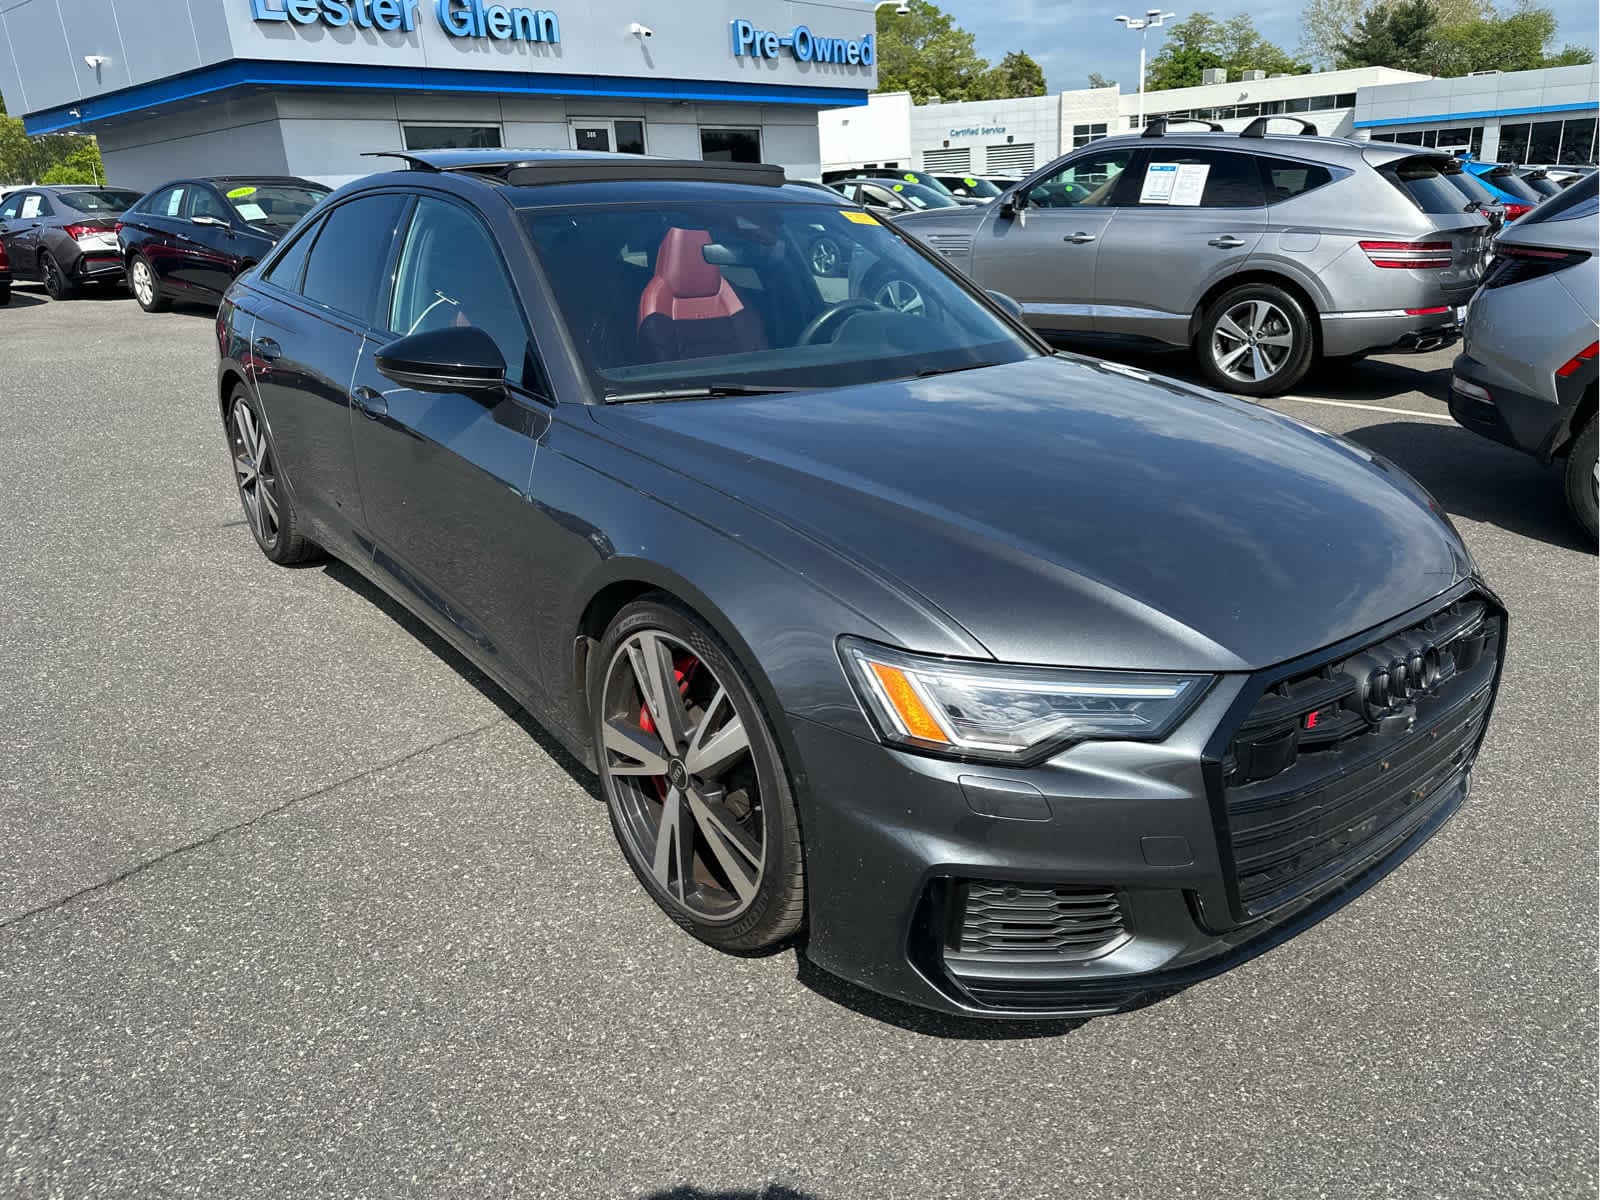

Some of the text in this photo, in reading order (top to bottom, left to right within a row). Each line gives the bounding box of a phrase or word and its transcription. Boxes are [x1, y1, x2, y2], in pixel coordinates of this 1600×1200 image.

[434, 0, 561, 44] Glenn
[731, 19, 874, 66] Pre-Owned
[950, 126, 1006, 137] Certified Service
